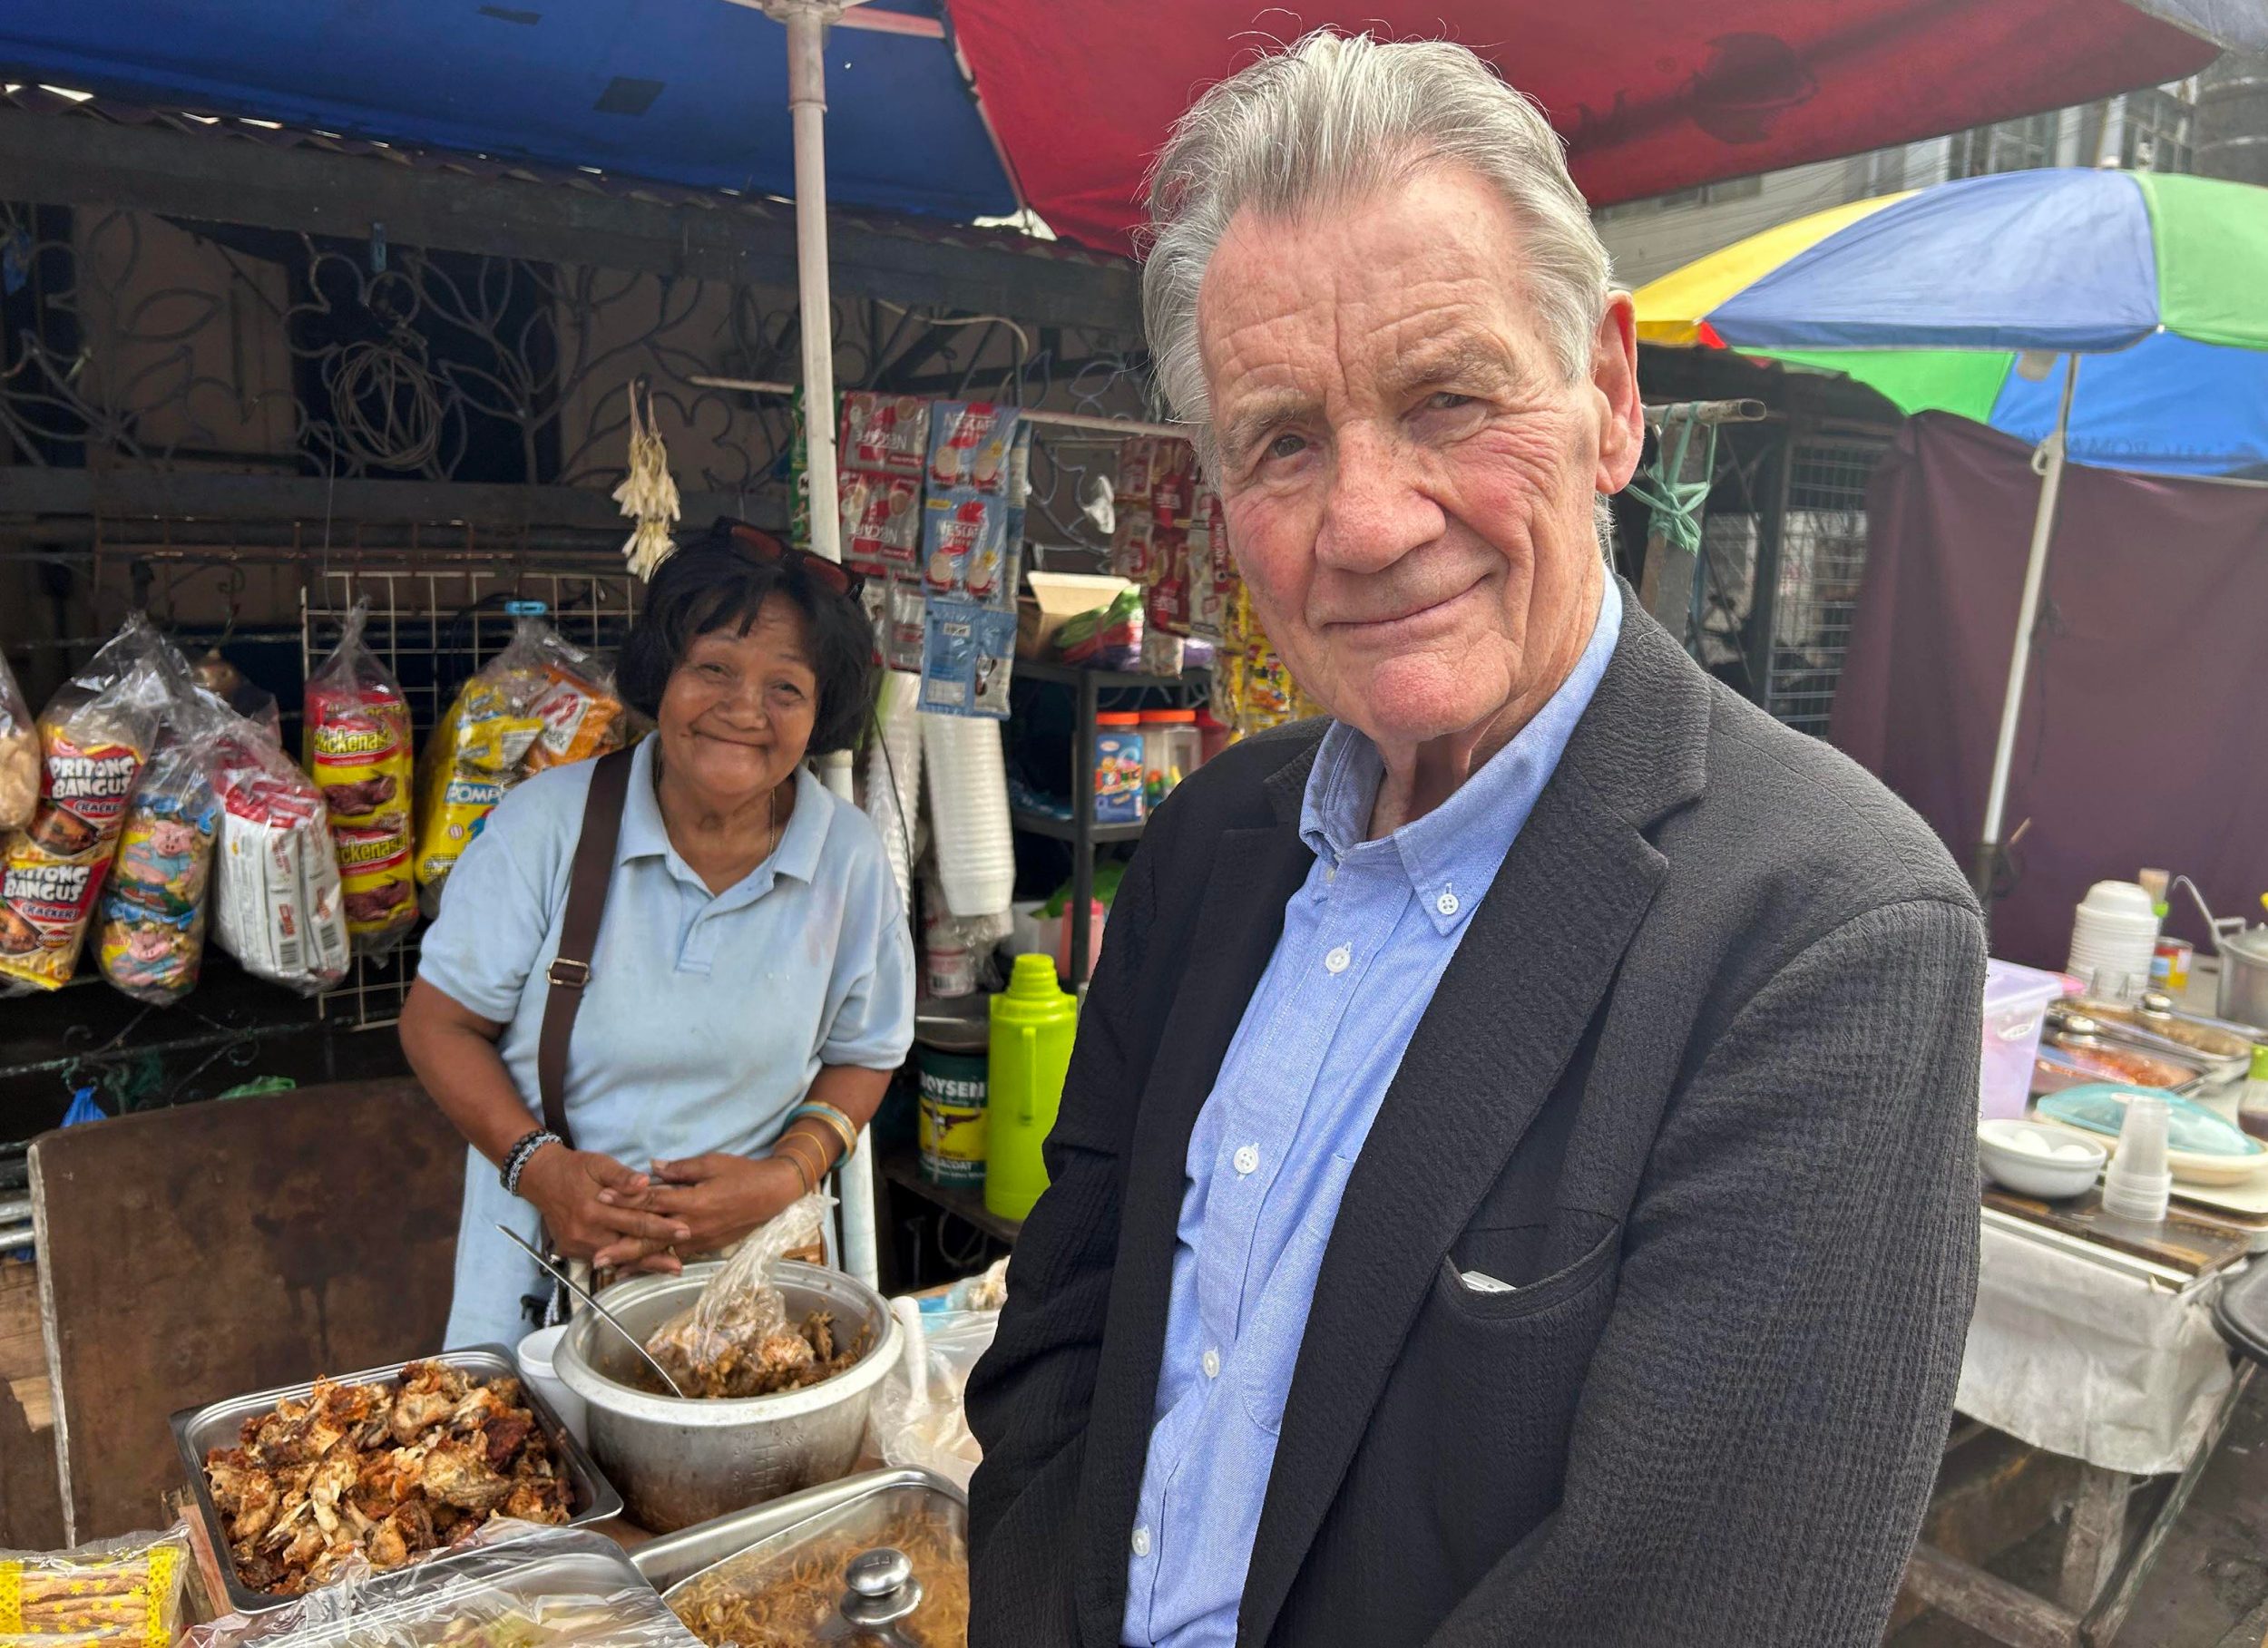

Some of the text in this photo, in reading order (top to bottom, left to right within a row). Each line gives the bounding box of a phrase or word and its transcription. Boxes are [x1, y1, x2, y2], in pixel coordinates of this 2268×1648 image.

[49, 756, 135, 778] PRITONG
[52, 776, 129, 800] BANGUS
[4, 878, 83, 902] BANGUS
